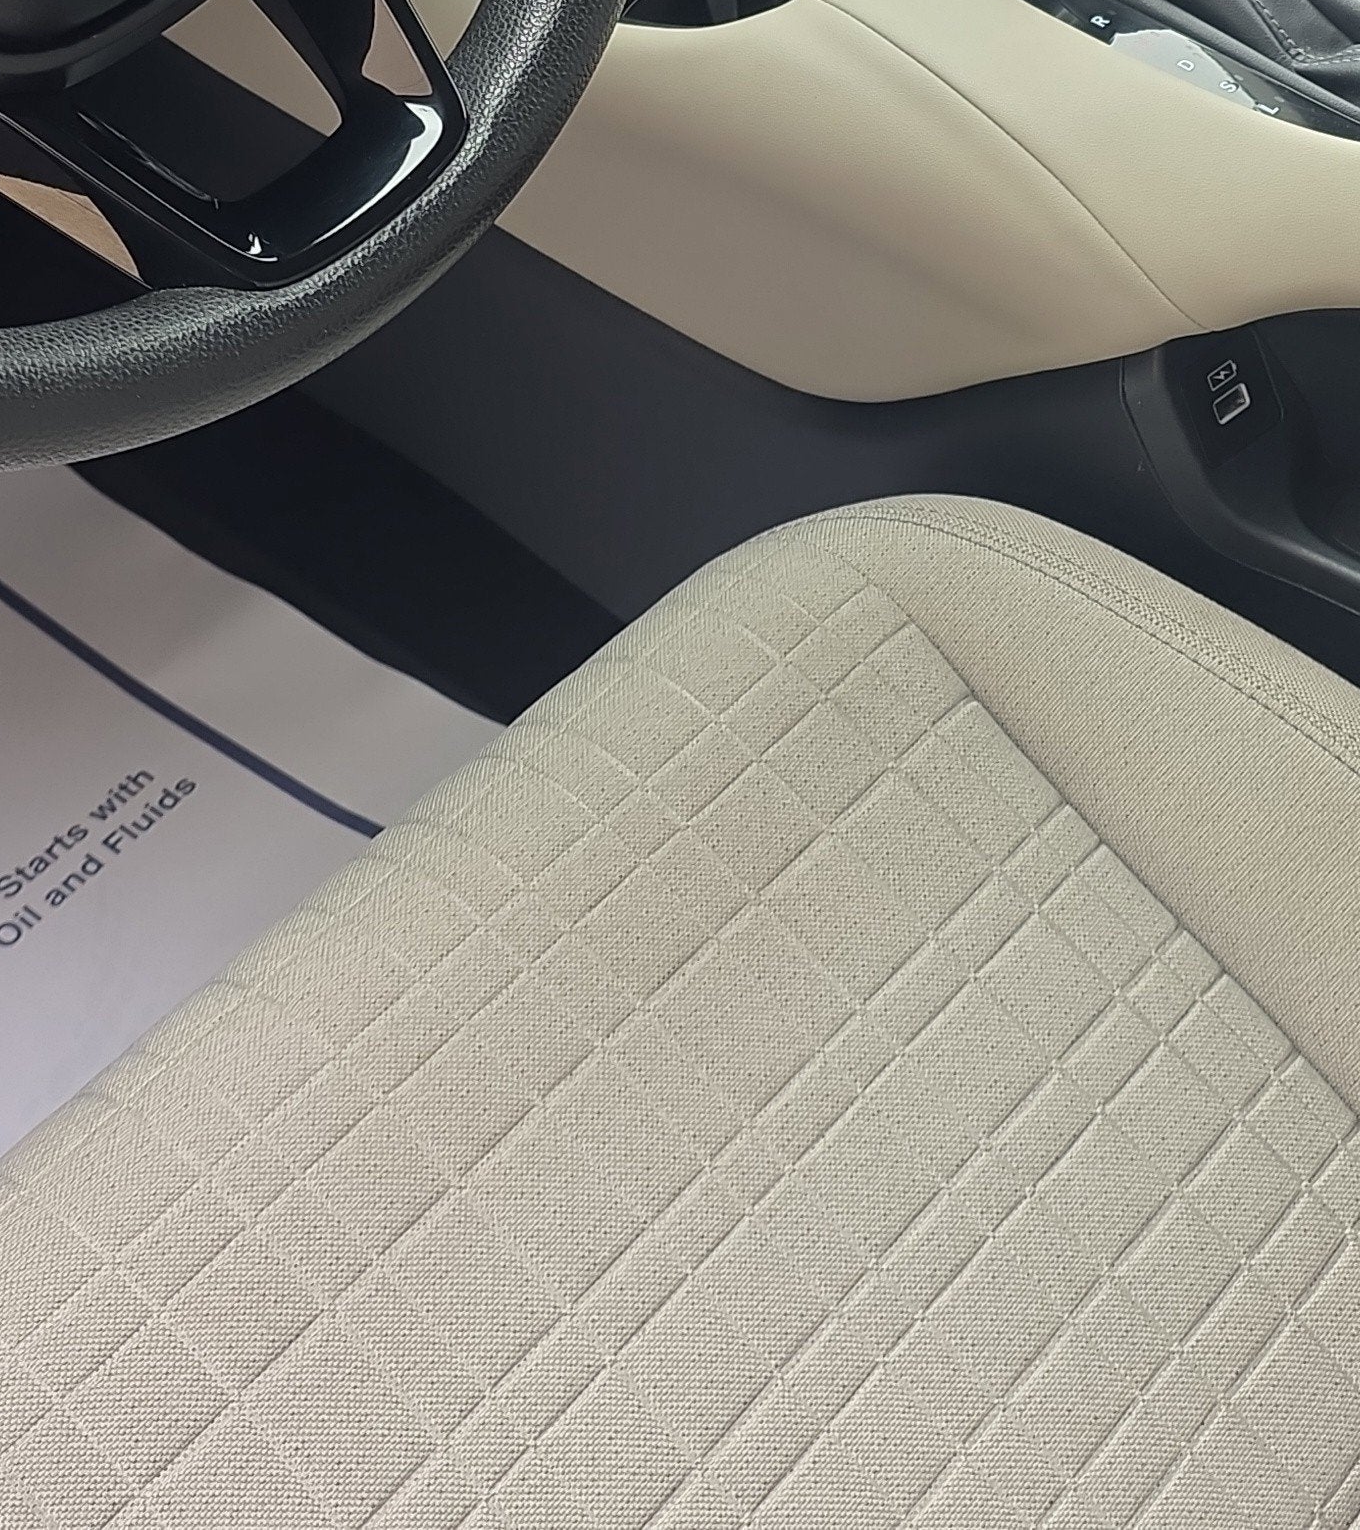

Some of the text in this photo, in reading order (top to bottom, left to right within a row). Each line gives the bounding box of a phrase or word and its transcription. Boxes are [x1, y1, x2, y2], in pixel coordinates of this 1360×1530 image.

[1090, 14, 1112, 29] R
[1176, 59, 1197, 73] D
[1219, 79, 1241, 94] S
[1256, 101, 1281, 116] L
[88, 768, 156, 824] with
[44, 852, 105, 909] and
[101, 773, 199, 857] Fluids
